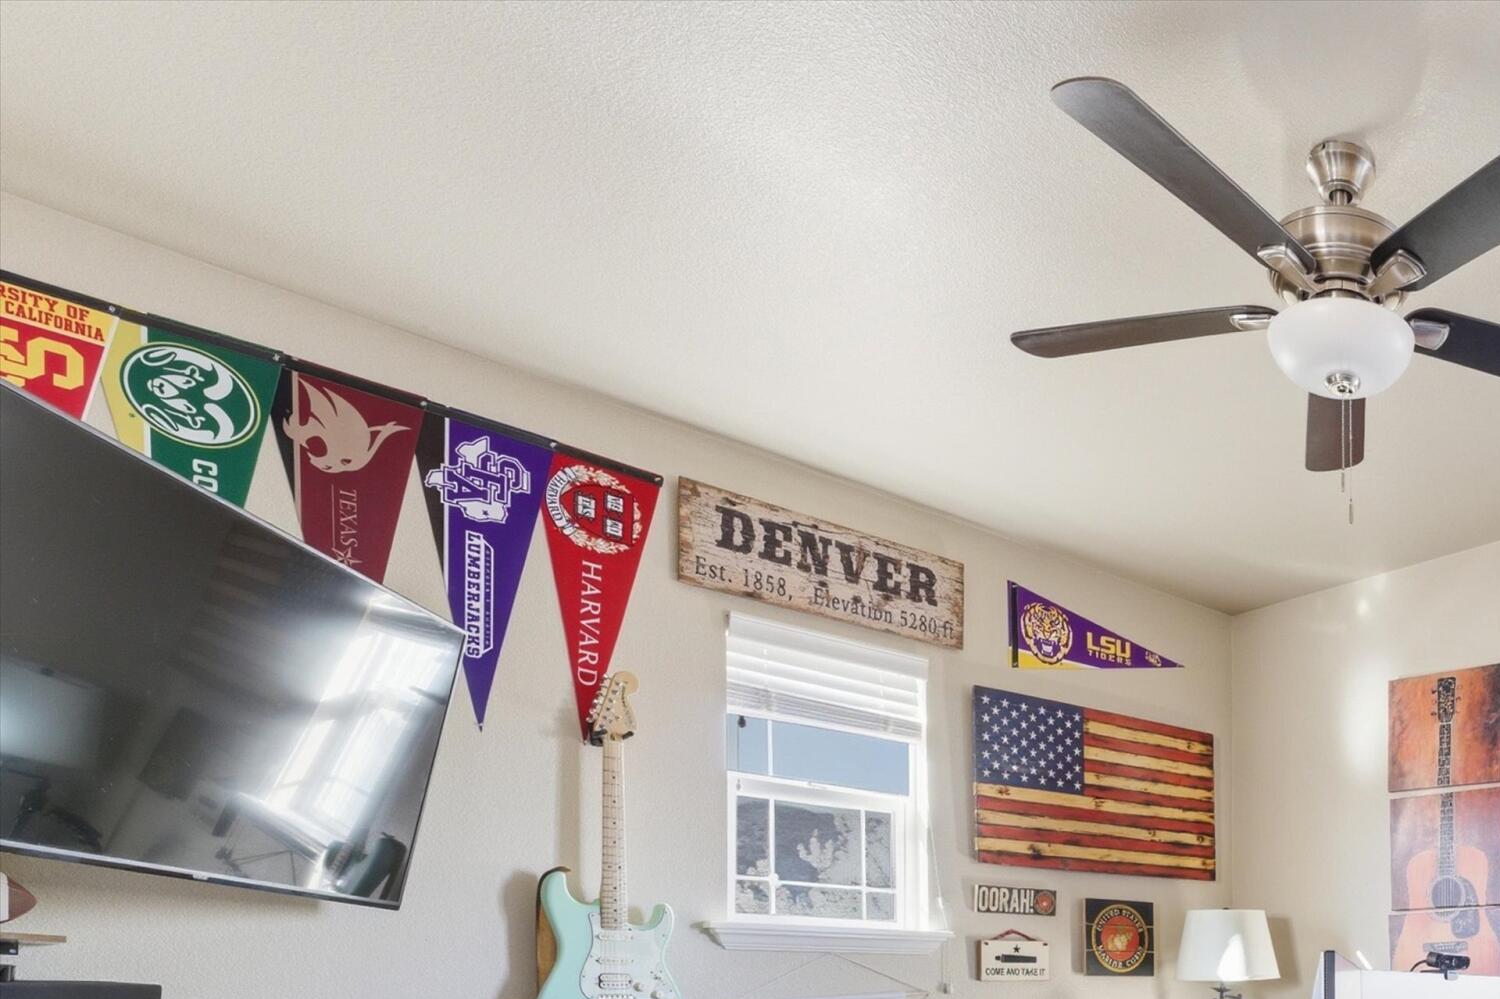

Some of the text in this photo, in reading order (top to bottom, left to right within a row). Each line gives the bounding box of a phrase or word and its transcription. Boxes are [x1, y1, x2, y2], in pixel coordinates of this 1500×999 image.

[5, 301, 104, 341] CALIFORNIA
[66, 304, 89, 321] OF
[339, 488, 358, 548] TEXAS
[715, 505, 938, 606] DENVER
[467, 532, 482, 657] LUMBERJACKS
[694, 555, 733, 583] Est.
[743, 568, 793, 601] 1858,
[813, 587, 893, 624] Elevation
[577, 560, 602, 686] HARVARD
[1087, 632, 1131, 659] LSU
[1088, 650, 1132, 666] TIGERS
[979, 886, 1034, 914] OORAH!
[1096, 909, 1120, 932] UNITED
[985, 967, 1046, 976] COME AND TAKE IT
